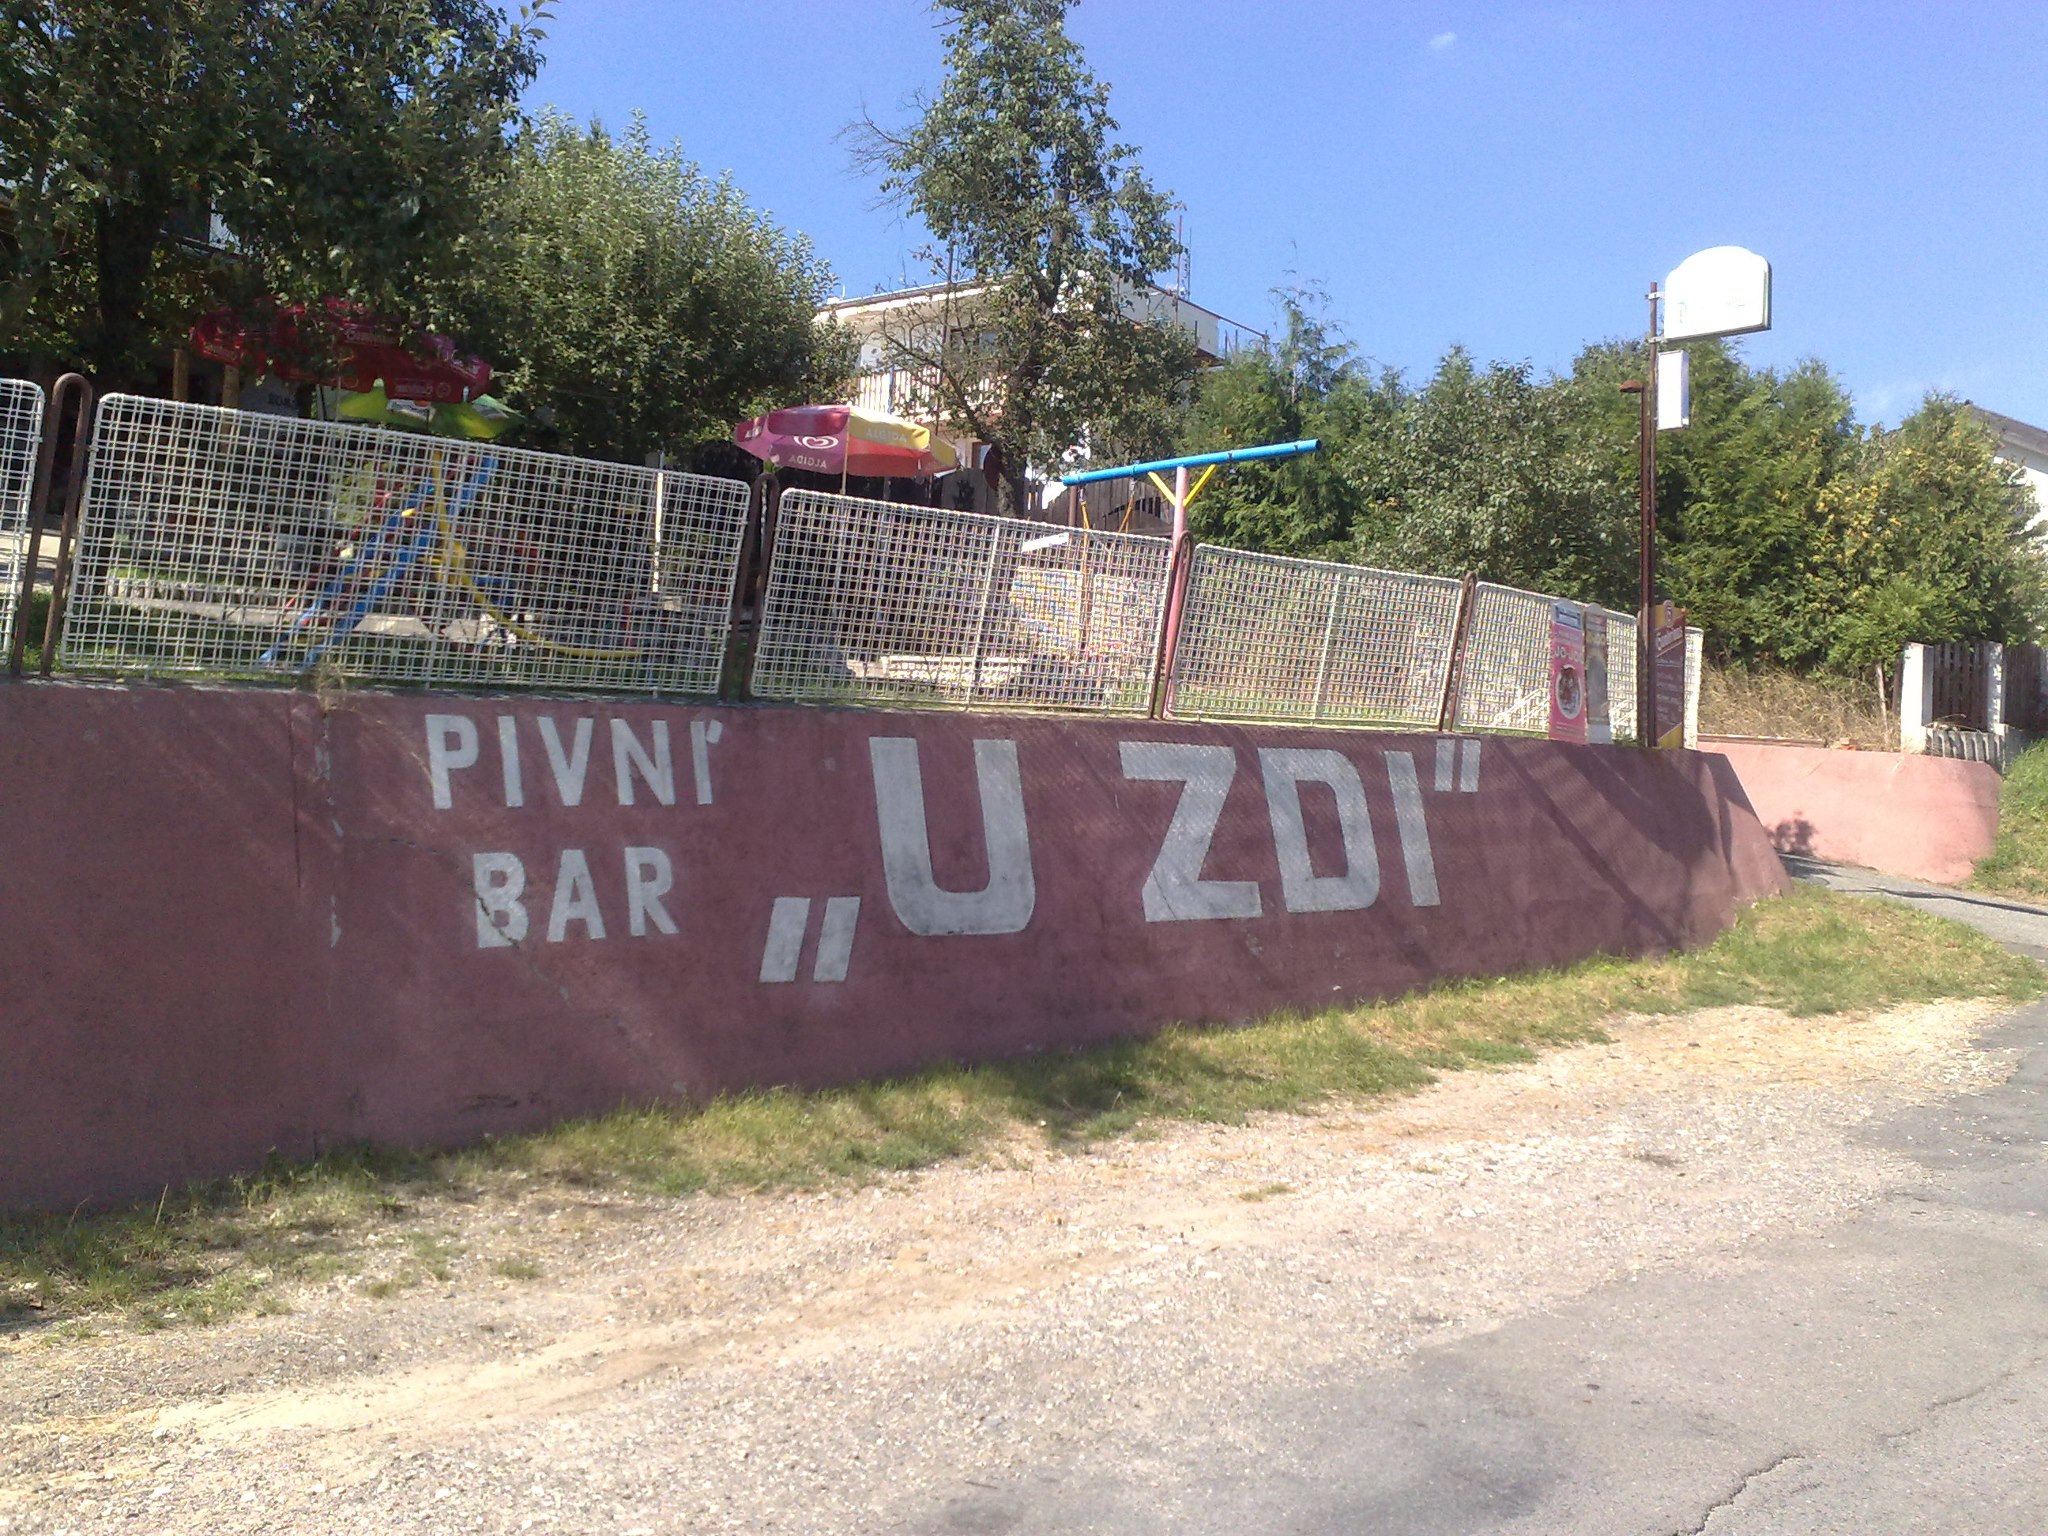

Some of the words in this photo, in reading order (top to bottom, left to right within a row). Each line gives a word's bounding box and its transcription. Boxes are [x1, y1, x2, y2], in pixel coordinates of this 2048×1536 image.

[864, 428, 907, 443] ALGIDA
[425, 714, 724, 809] PIVNÍ
[473, 846, 680, 948] BAR
